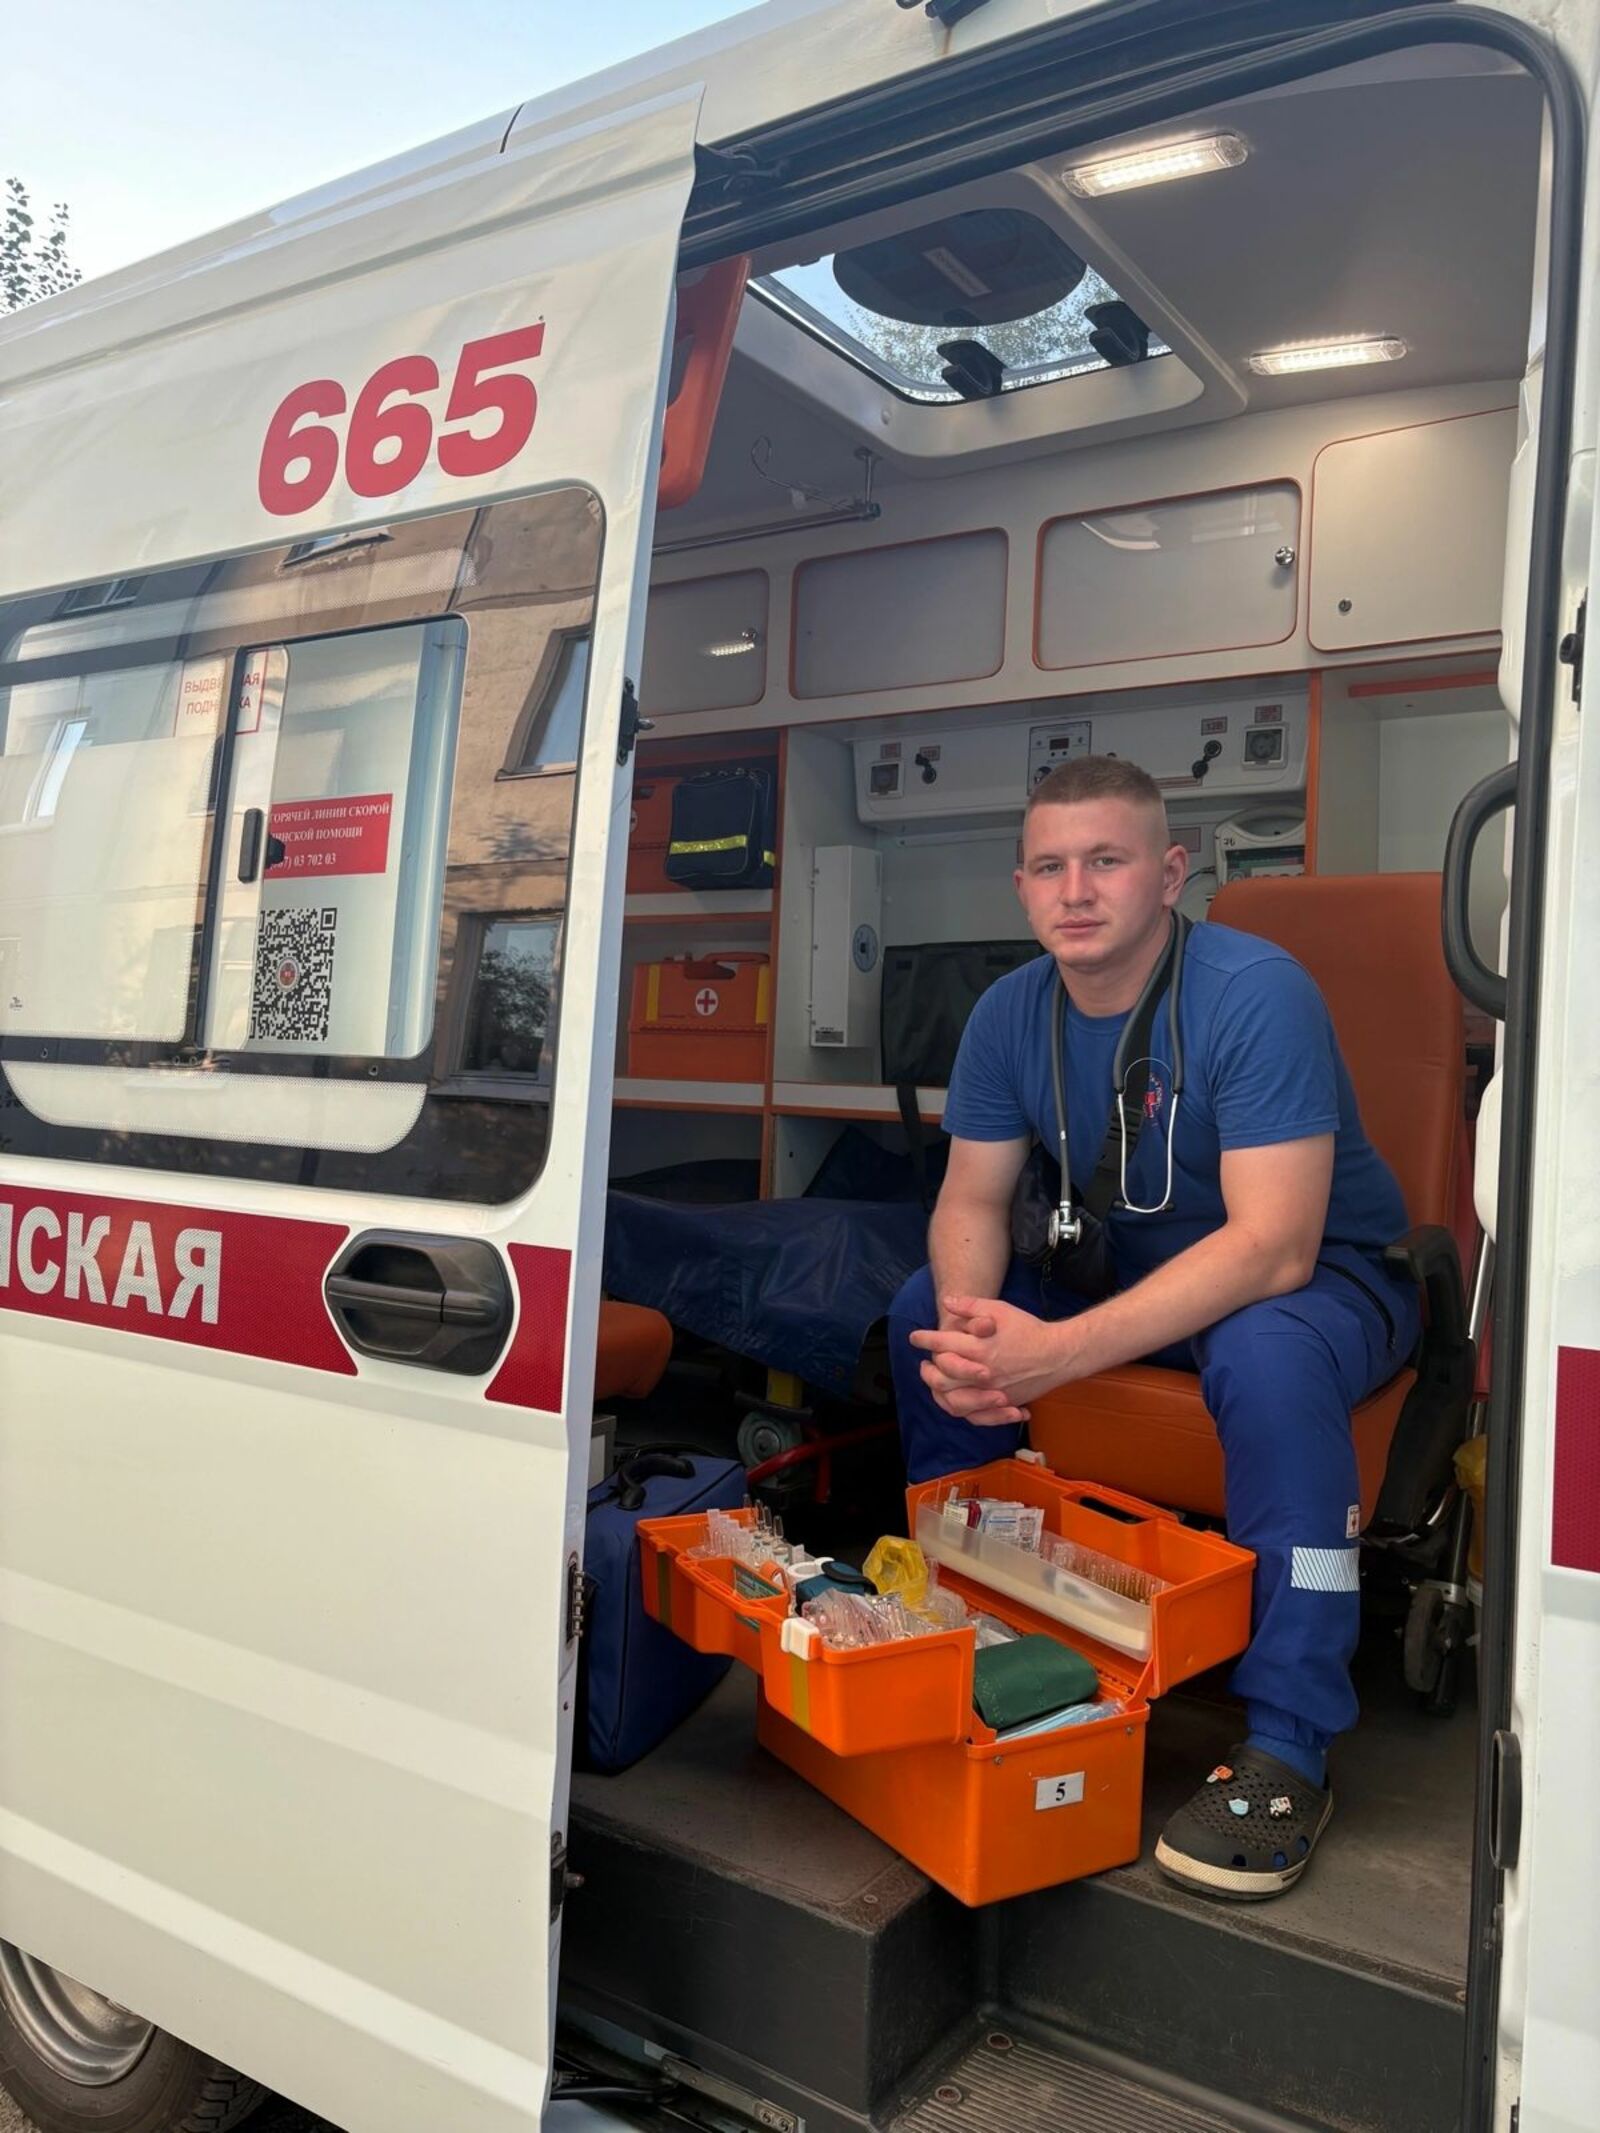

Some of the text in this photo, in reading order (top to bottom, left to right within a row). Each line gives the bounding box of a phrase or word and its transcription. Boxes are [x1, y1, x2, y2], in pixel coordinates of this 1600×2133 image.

[258, 321, 546, 517] 665
[311, 807, 346, 821] ЛИНИИ
[348, 802, 390, 817] СКОРОЙ
[315, 826, 363, 841] ПОМОЩИ
[294, 855, 305, 867] 03
[308, 854, 323, 867] 702
[324, 853, 337, 866] 03
[1055, 1781, 1067, 1802] 5
